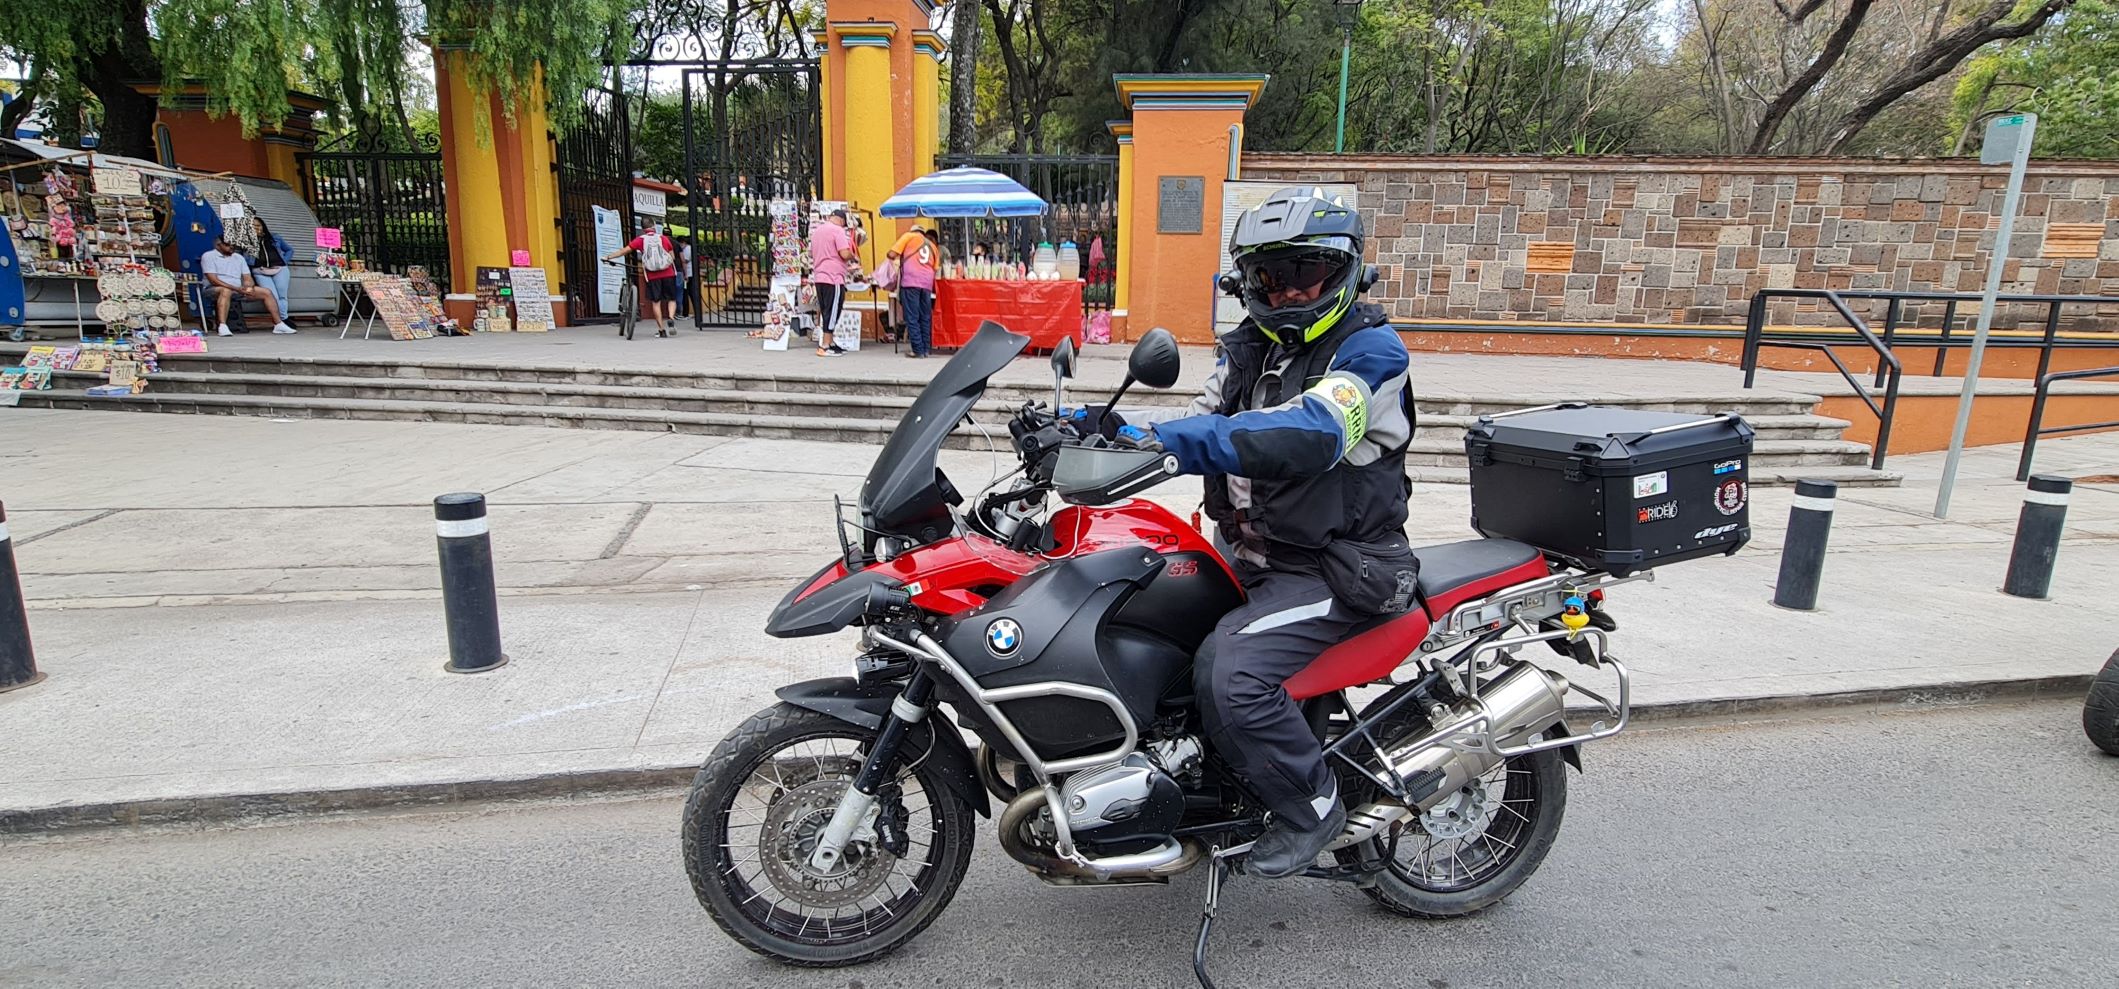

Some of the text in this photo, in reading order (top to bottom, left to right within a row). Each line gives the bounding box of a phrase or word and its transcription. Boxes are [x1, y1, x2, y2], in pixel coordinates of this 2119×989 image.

[919, 244, 930, 264] 9
[1714, 460, 1741, 468] GoPro
[1167, 560, 1198, 578] GS
